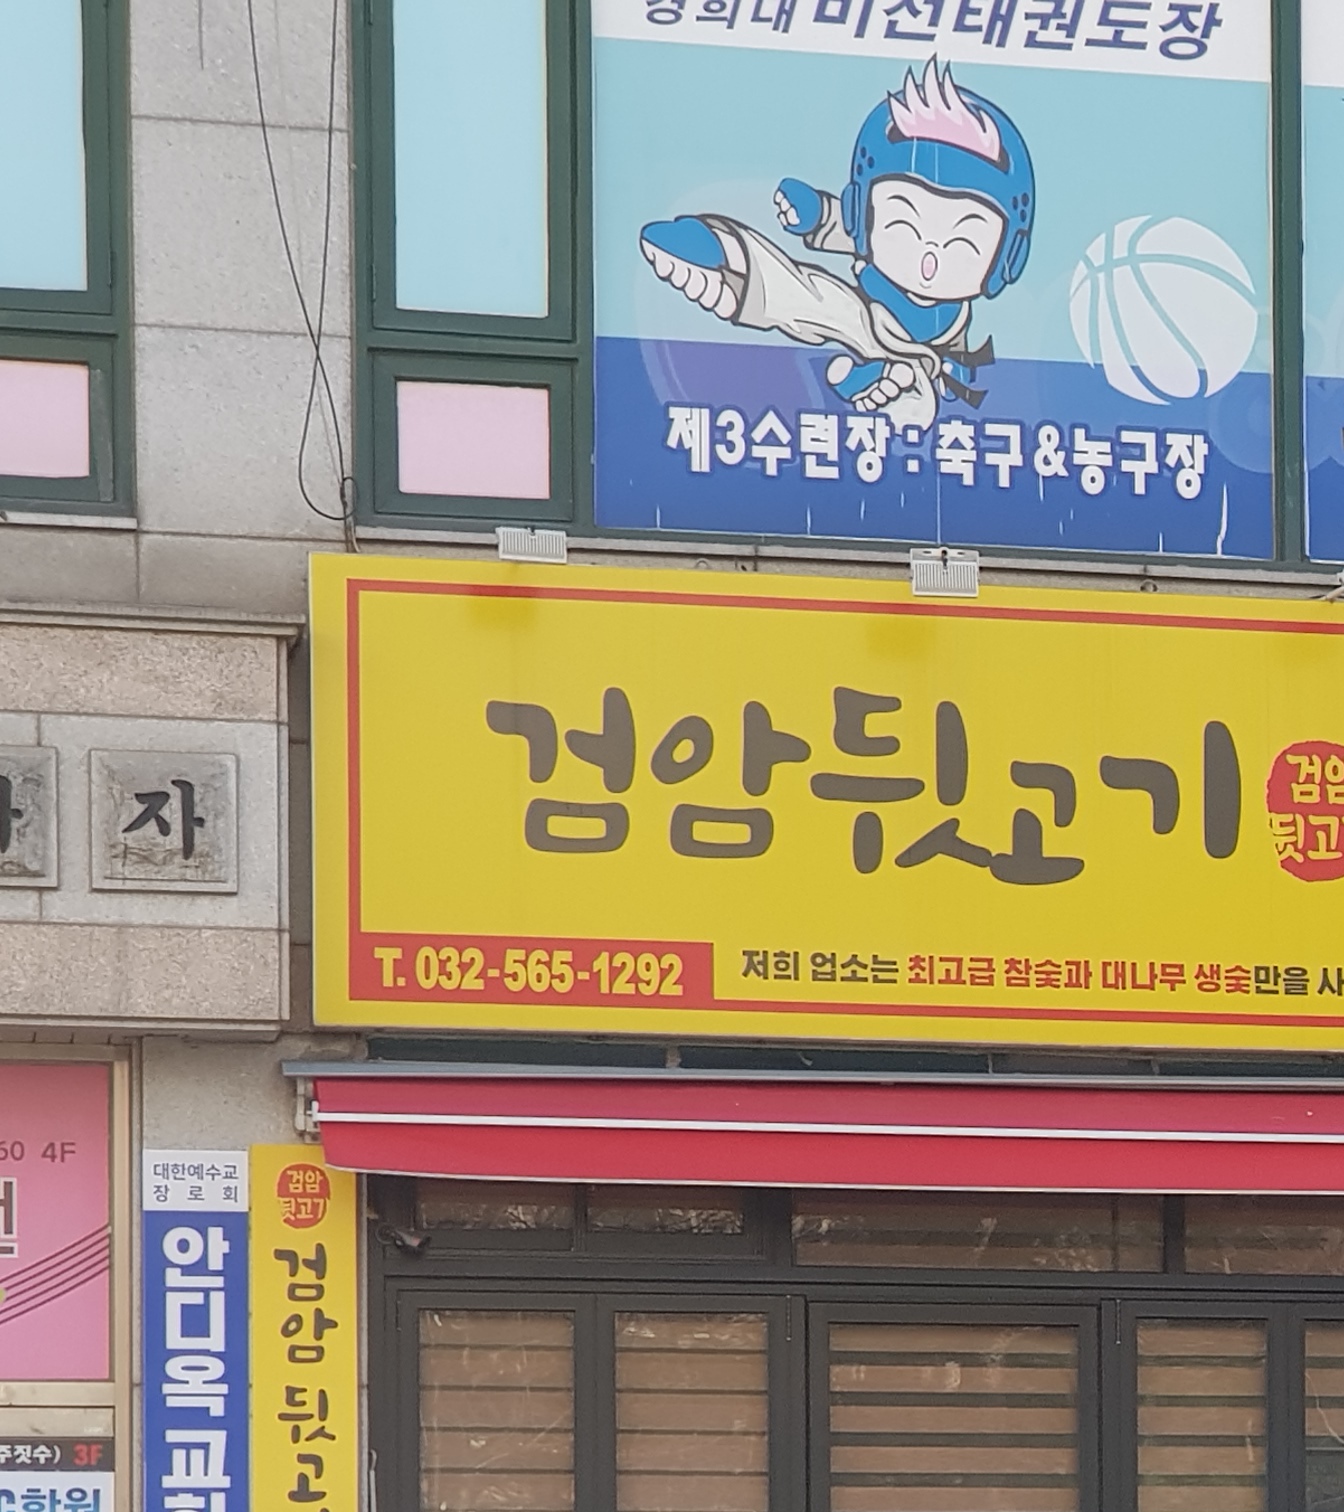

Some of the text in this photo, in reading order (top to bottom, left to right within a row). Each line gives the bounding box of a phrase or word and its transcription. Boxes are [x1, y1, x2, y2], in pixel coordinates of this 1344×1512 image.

[121, 779, 205, 861] 자
[415, 945, 684, 996] 032-565-1292
[740, 949, 801, 982] 저희
[809, 951, 901, 986] 업소는
[907, 954, 997, 989] 최고급
[1003, 957, 1093, 992] 참숯과
[1100, 960, 1187, 994] 대나무
[1194, 963, 1310, 998] 생숯만을
[41, 1141, 76, 1163] 4F
[152, 1162, 239, 1182] 대한예수교
[286, 1168, 324, 1193] 검암
[73, 1444, 102, 1466] 3F
